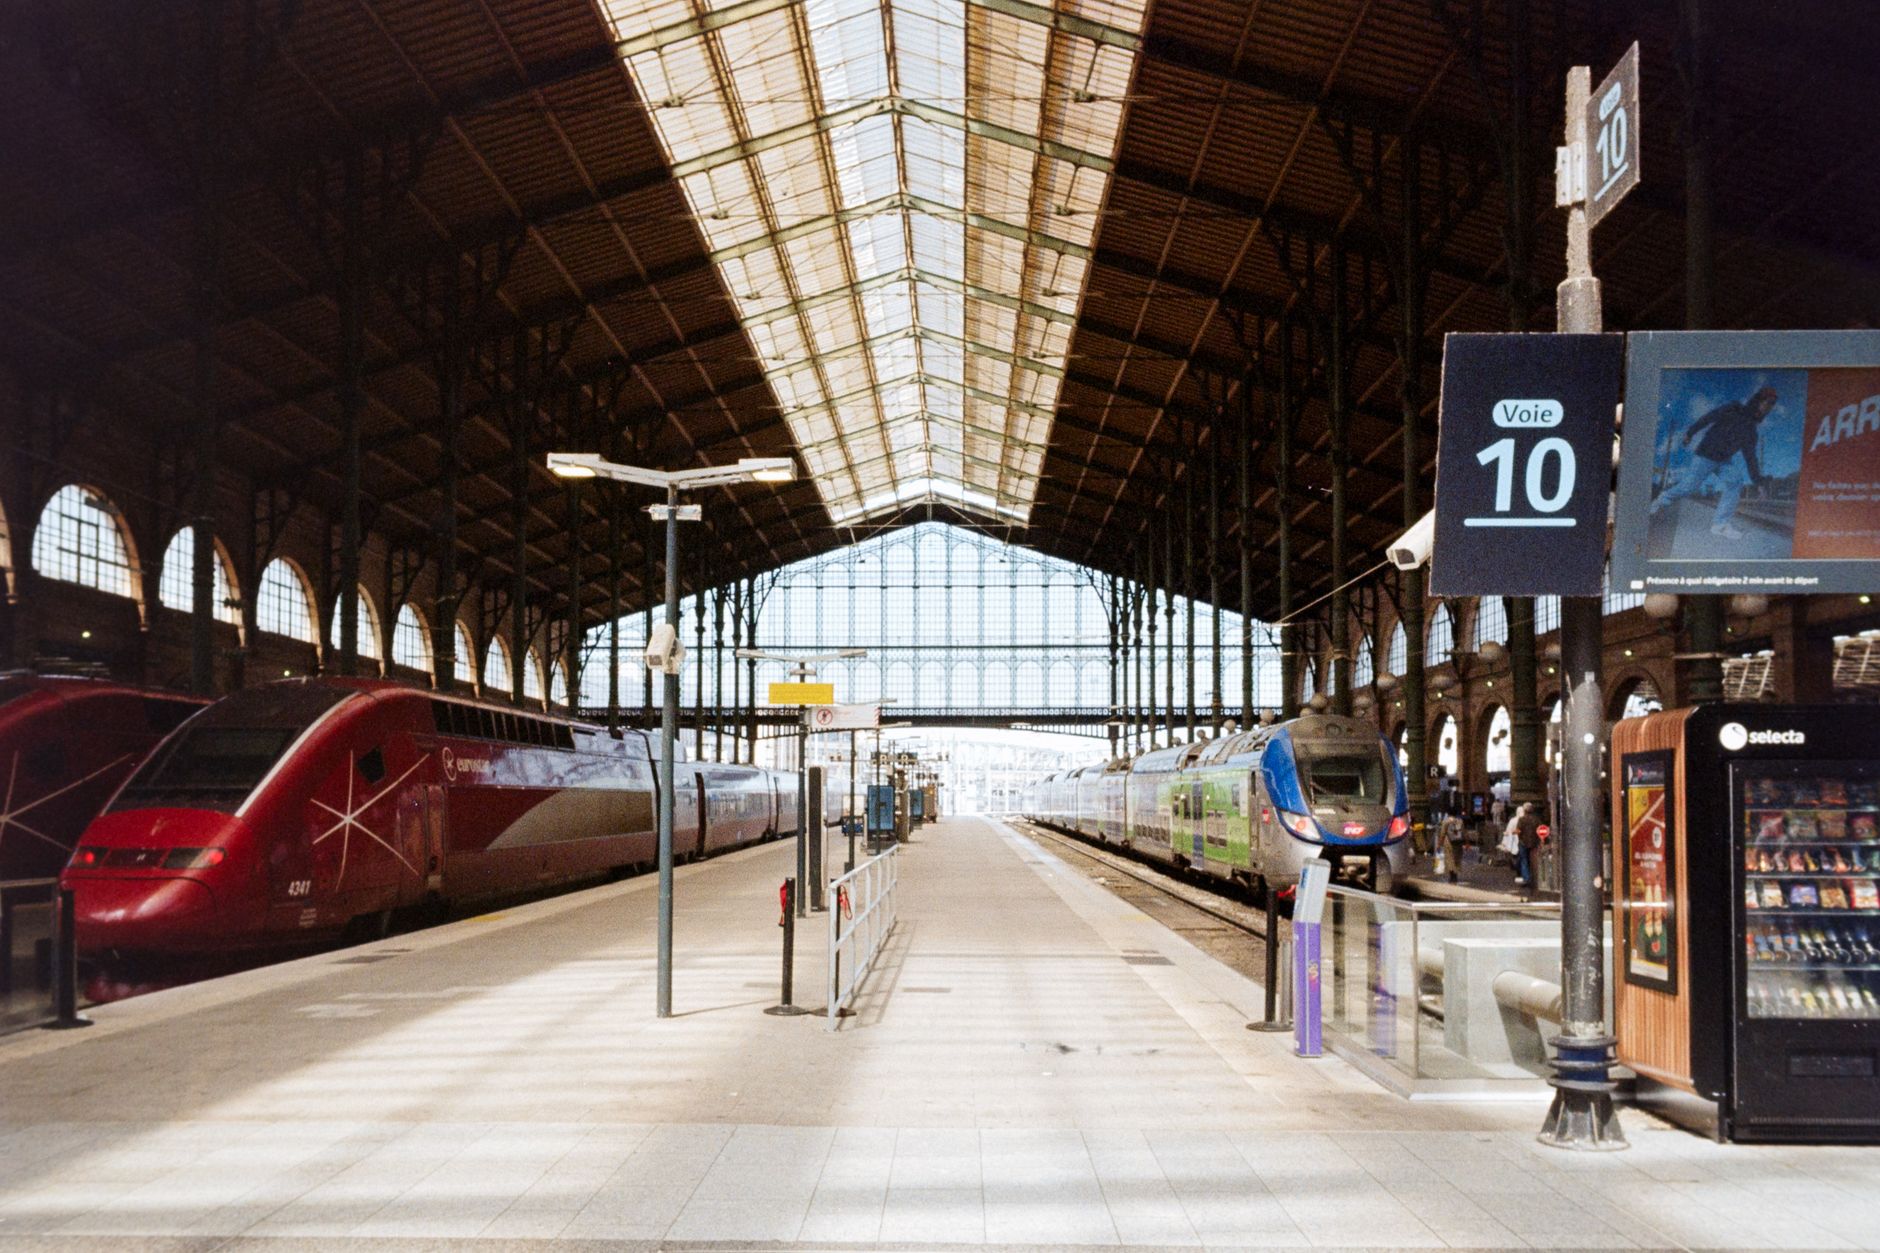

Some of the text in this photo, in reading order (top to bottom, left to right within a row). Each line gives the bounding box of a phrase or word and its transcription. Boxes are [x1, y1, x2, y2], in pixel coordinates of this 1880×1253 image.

[1596, 107, 1627, 181] 10
[1503, 404, 1553, 423] Voie
[1476, 437, 1576, 513] 10
[1646, 576, 1680, 585] Présence
[1686, 577, 1702, 586] quai
[1703, 576, 1742, 586] obligatoire
[1742, 576, 1748, 584] 2
[1749, 576, 1764, 584] min
[1794, 576, 1819, 585] départ
[1748, 729, 1805, 744] selecta
[1430, 767, 1438, 777] R
[288, 880, 311, 896] 4341
